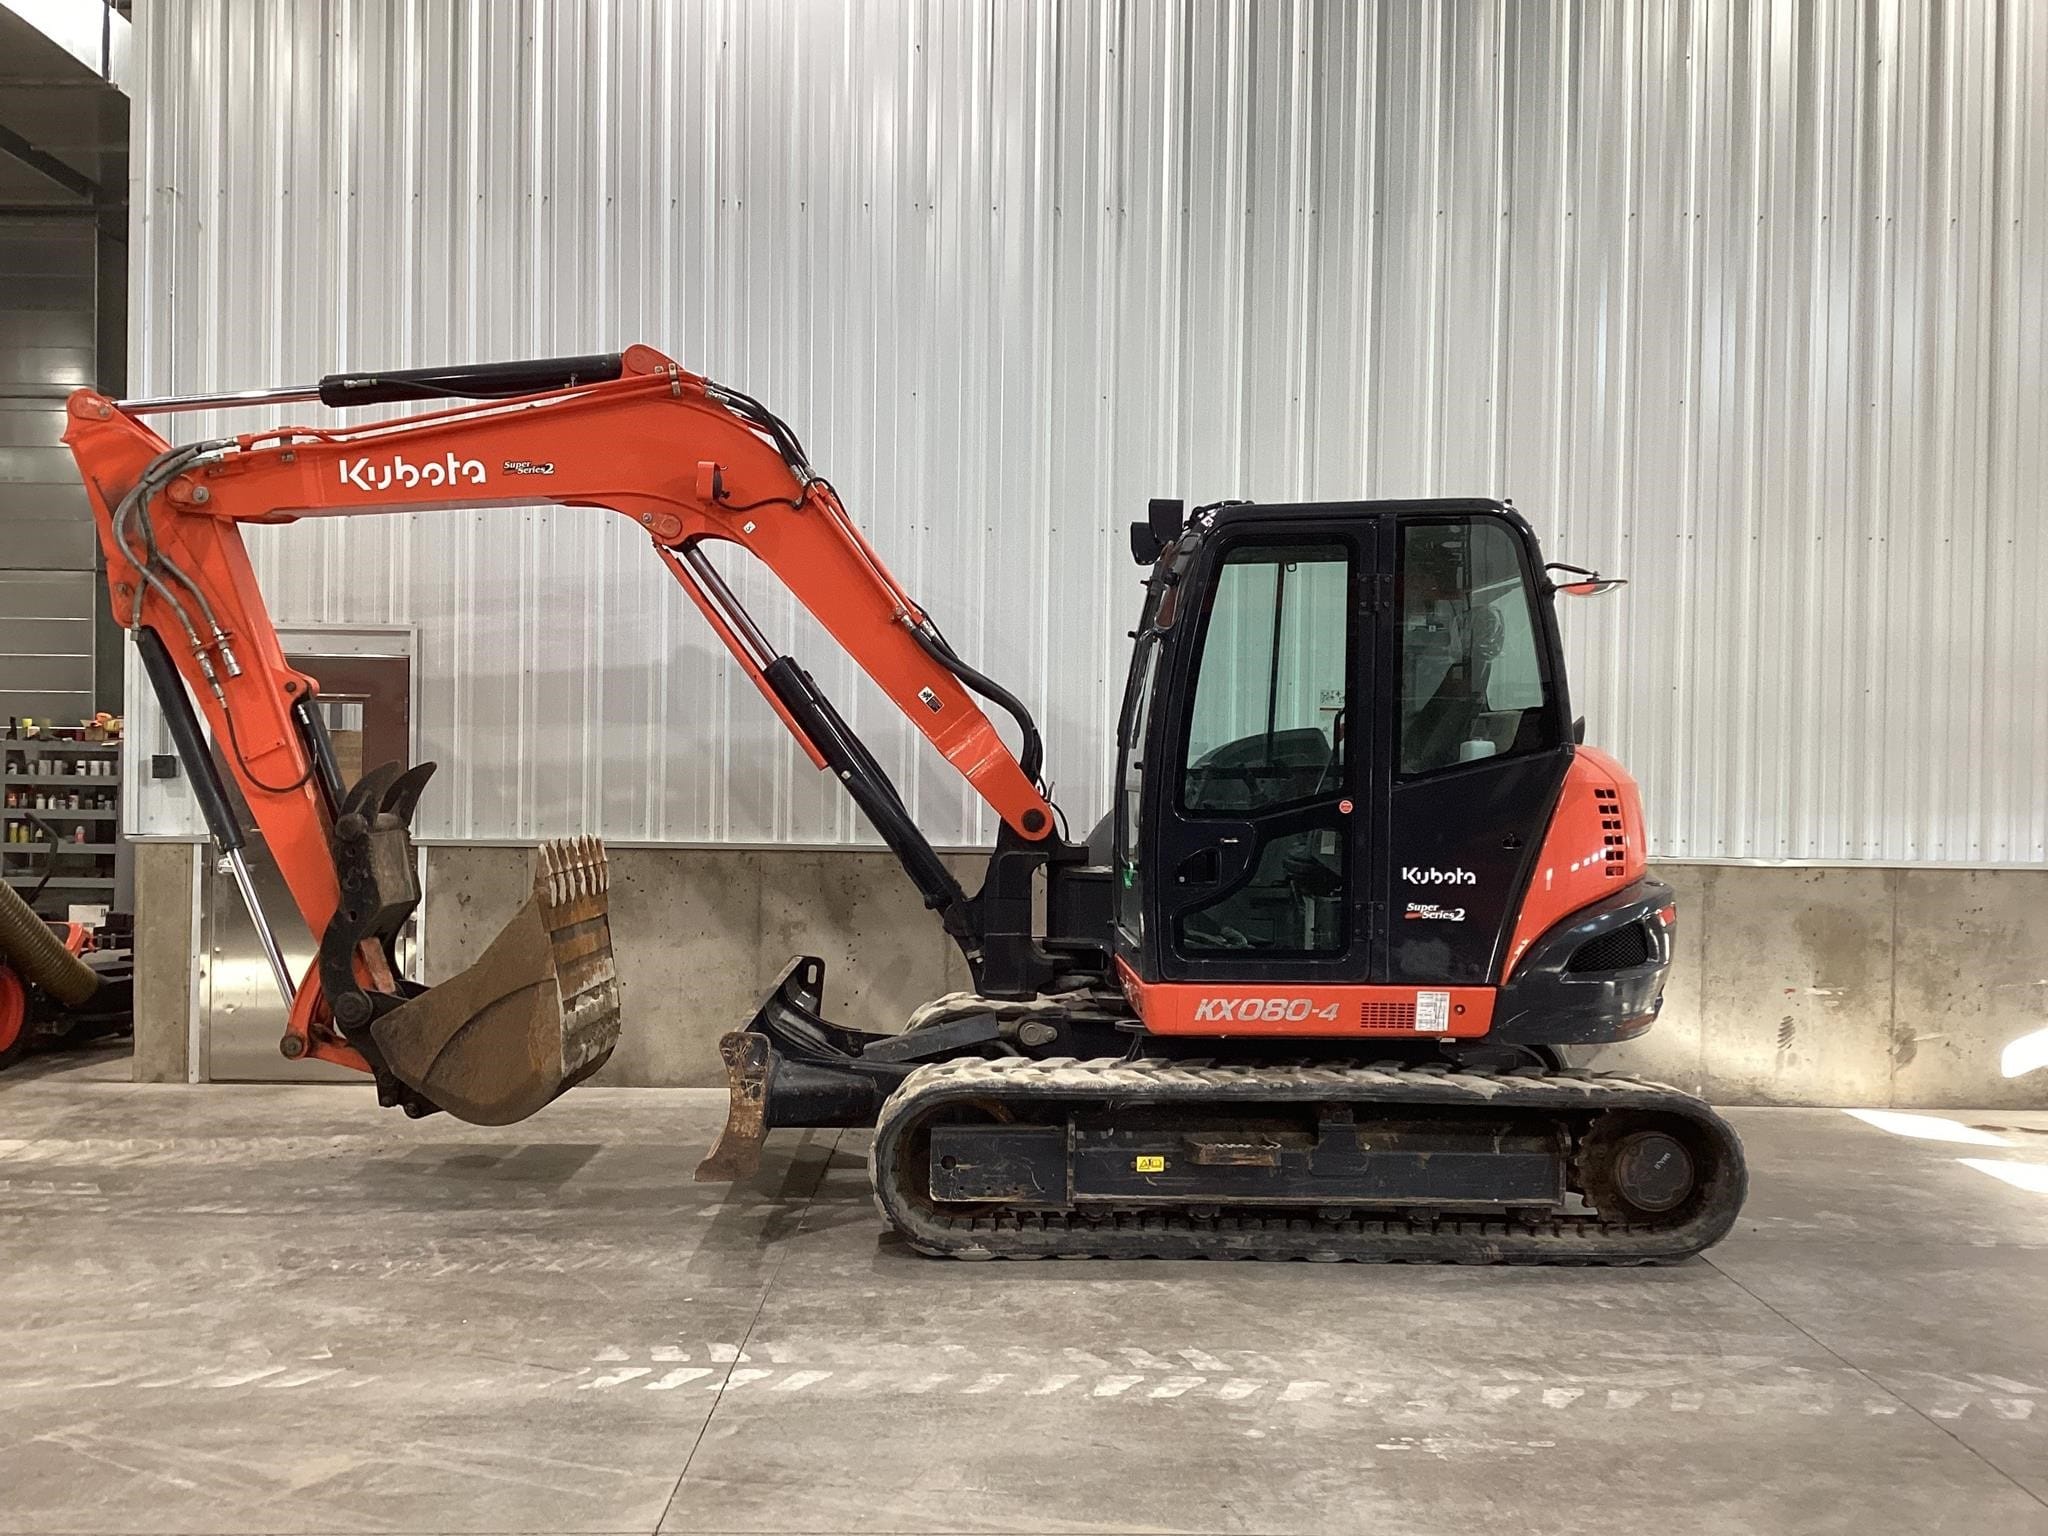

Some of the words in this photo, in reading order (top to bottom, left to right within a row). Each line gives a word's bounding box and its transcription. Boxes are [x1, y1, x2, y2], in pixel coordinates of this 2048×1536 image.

[338, 452, 487, 490] Kubota
[503, 460, 531, 470] Super
[1402, 867, 1476, 885] Kubota
[1406, 902, 1440, 914] Super
[1194, 998, 1340, 1021] KX080-4
